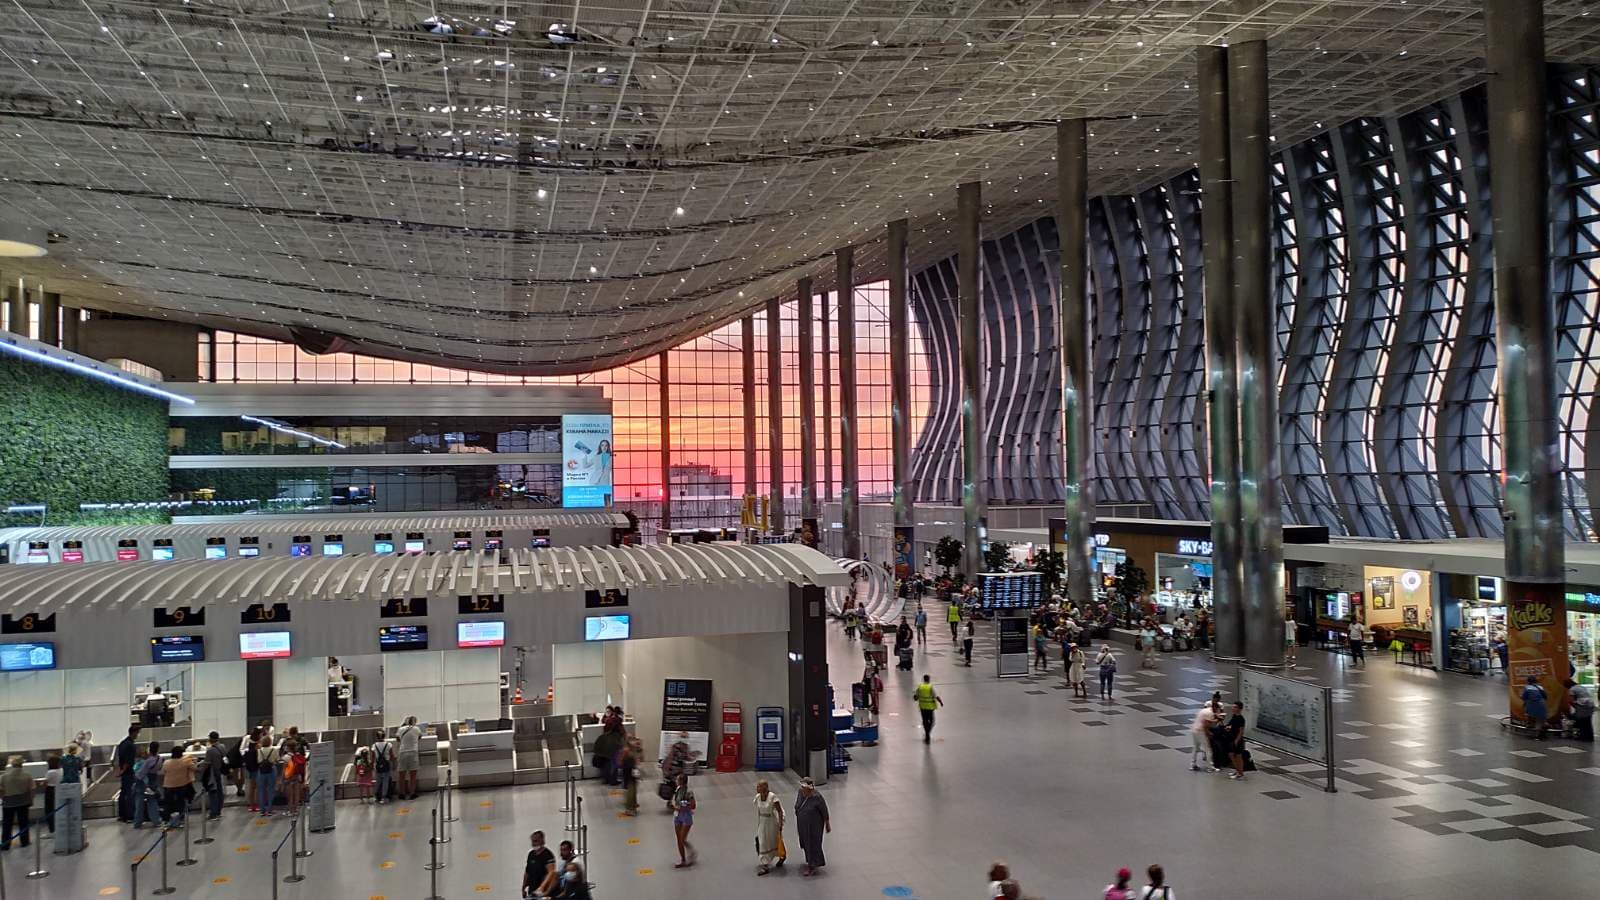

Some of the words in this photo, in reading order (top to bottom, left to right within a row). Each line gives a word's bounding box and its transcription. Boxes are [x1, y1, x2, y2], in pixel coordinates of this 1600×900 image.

[472, 598, 490, 611] 12
[599, 592, 615, 604] 13
[174, 610, 185, 624] 9
[255, 607, 276, 620] 10
[22, 616, 34, 630] 8
